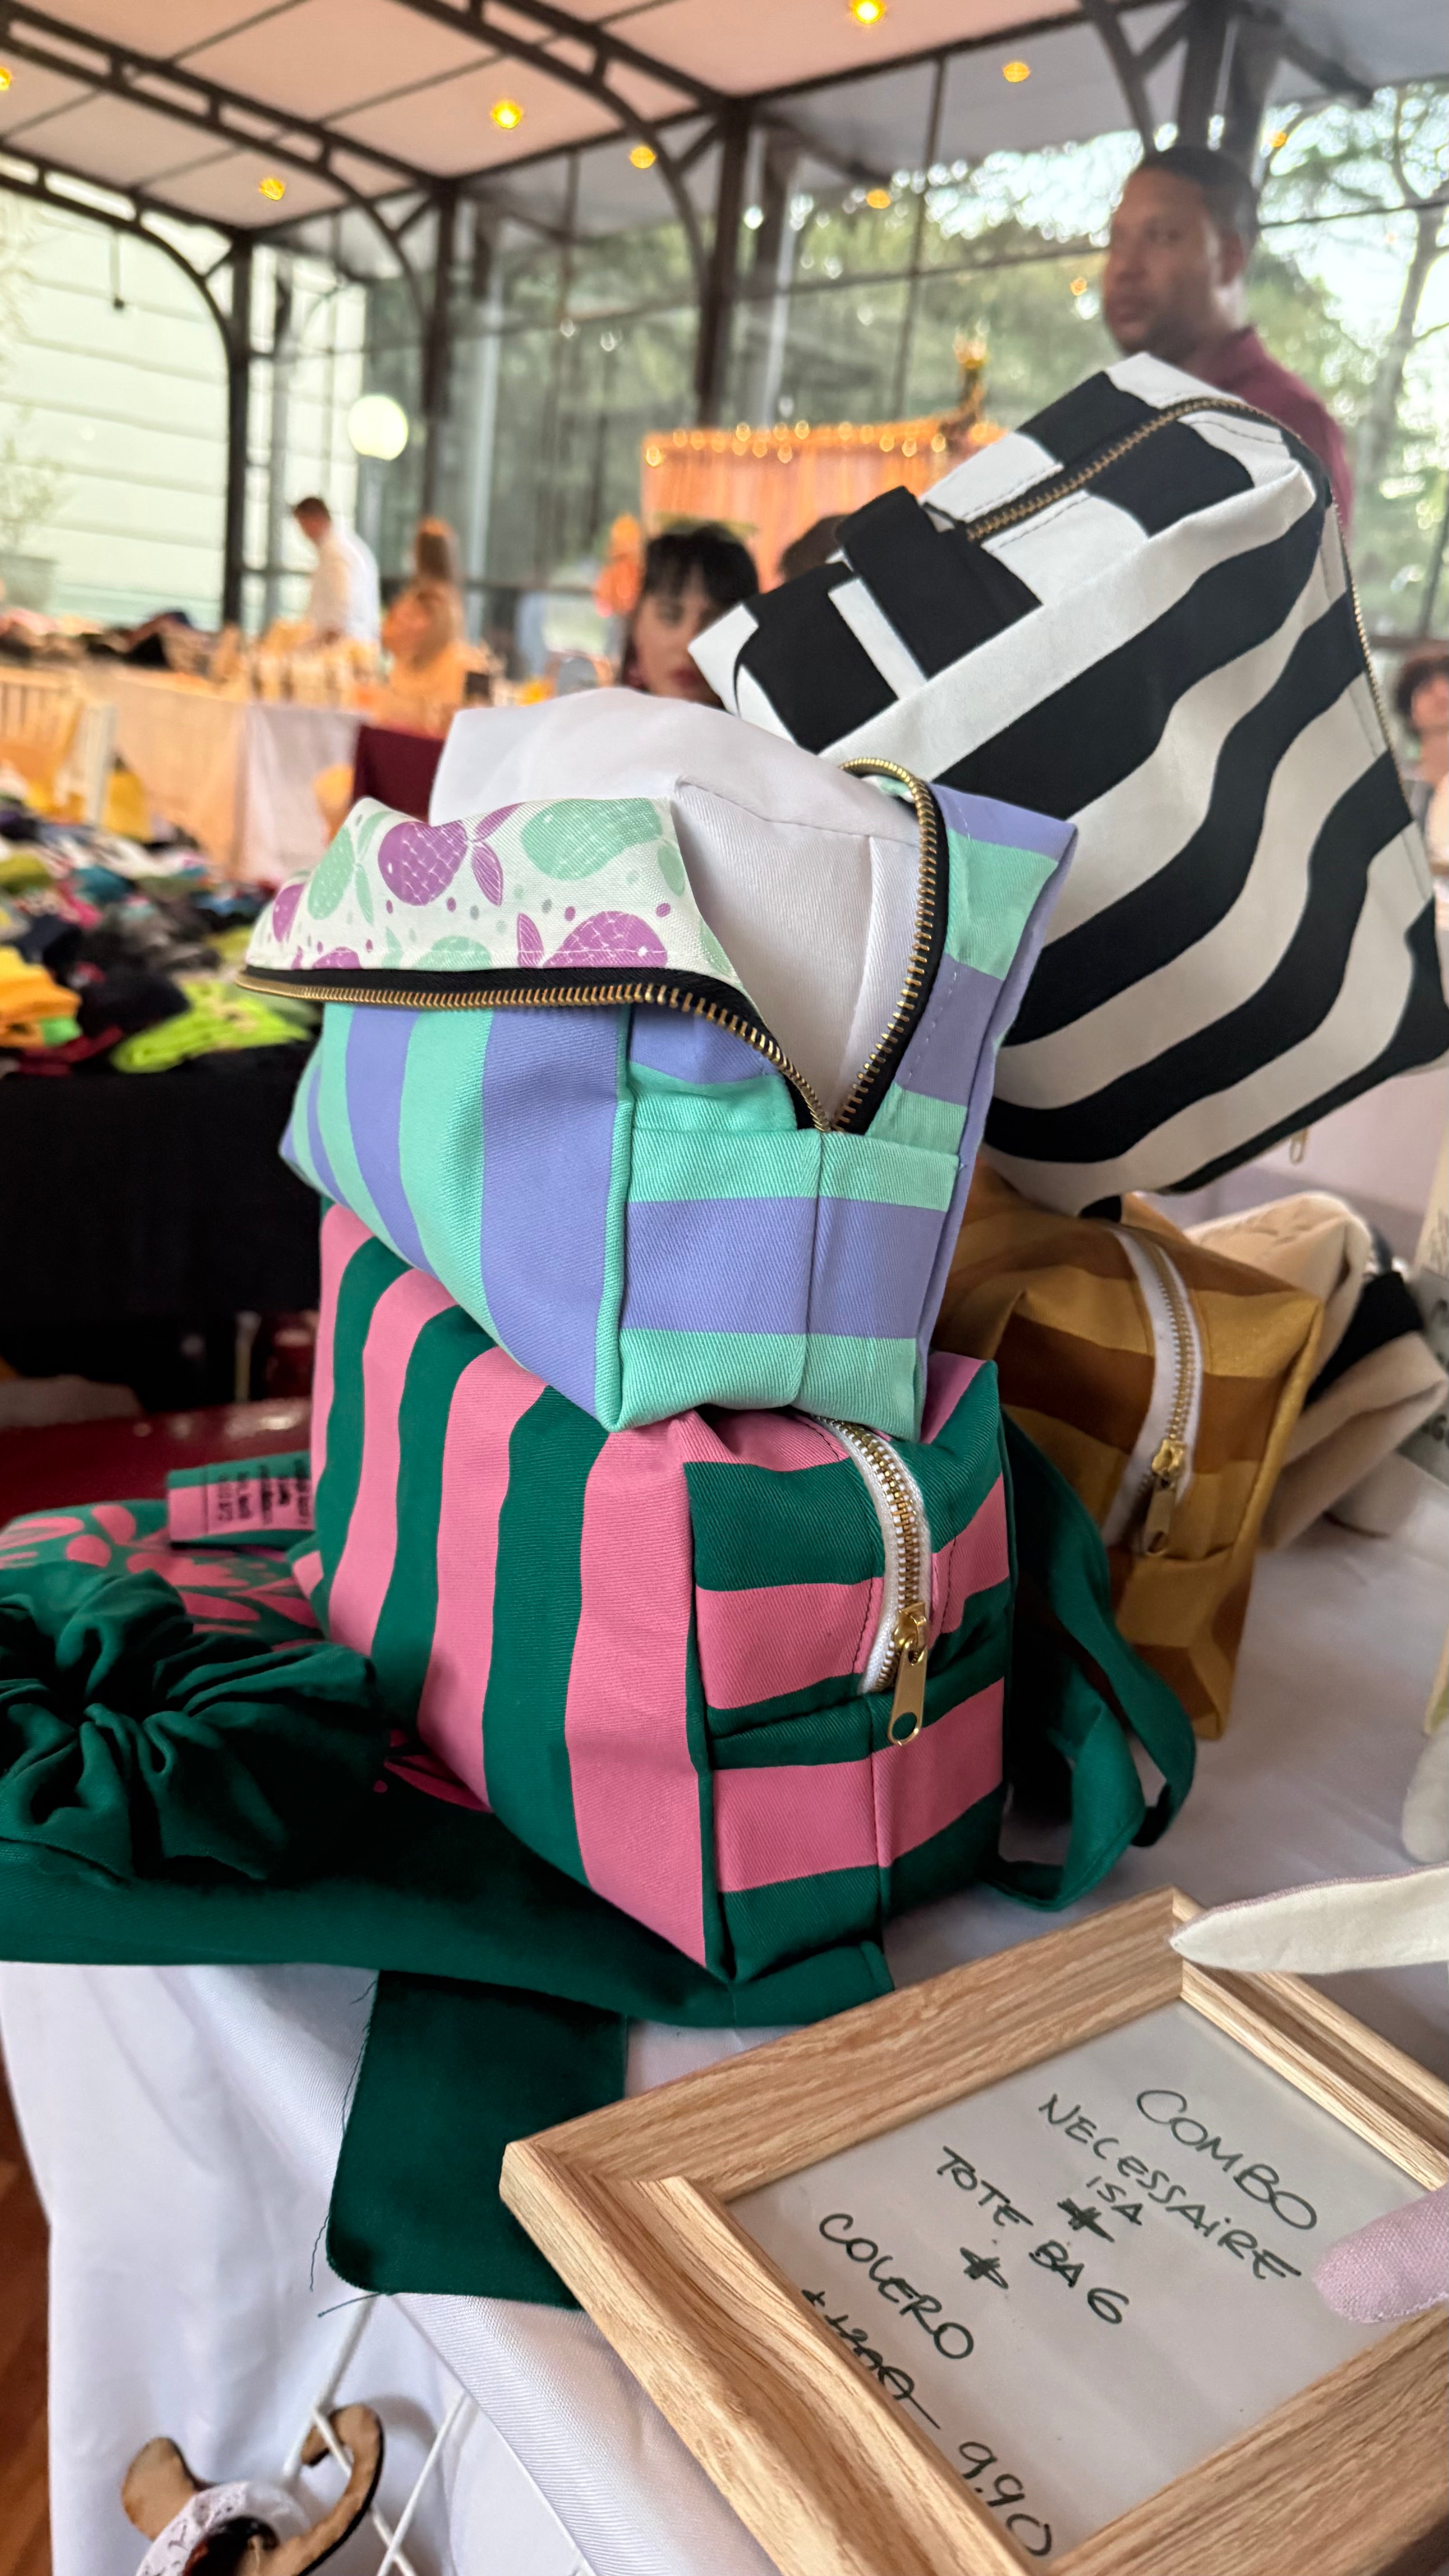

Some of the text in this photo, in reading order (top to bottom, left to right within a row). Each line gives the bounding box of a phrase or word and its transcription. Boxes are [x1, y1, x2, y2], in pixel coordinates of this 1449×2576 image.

[1038, 2093, 1302, 2280] NECESSAIRE
[1136, 2089, 1317, 2230] COMBO
[819, 2213, 974, 2359] COLERO
[936, 2145, 1129, 2324] TOTE BAG
[958, 2441, 1052, 2556] 9.90
